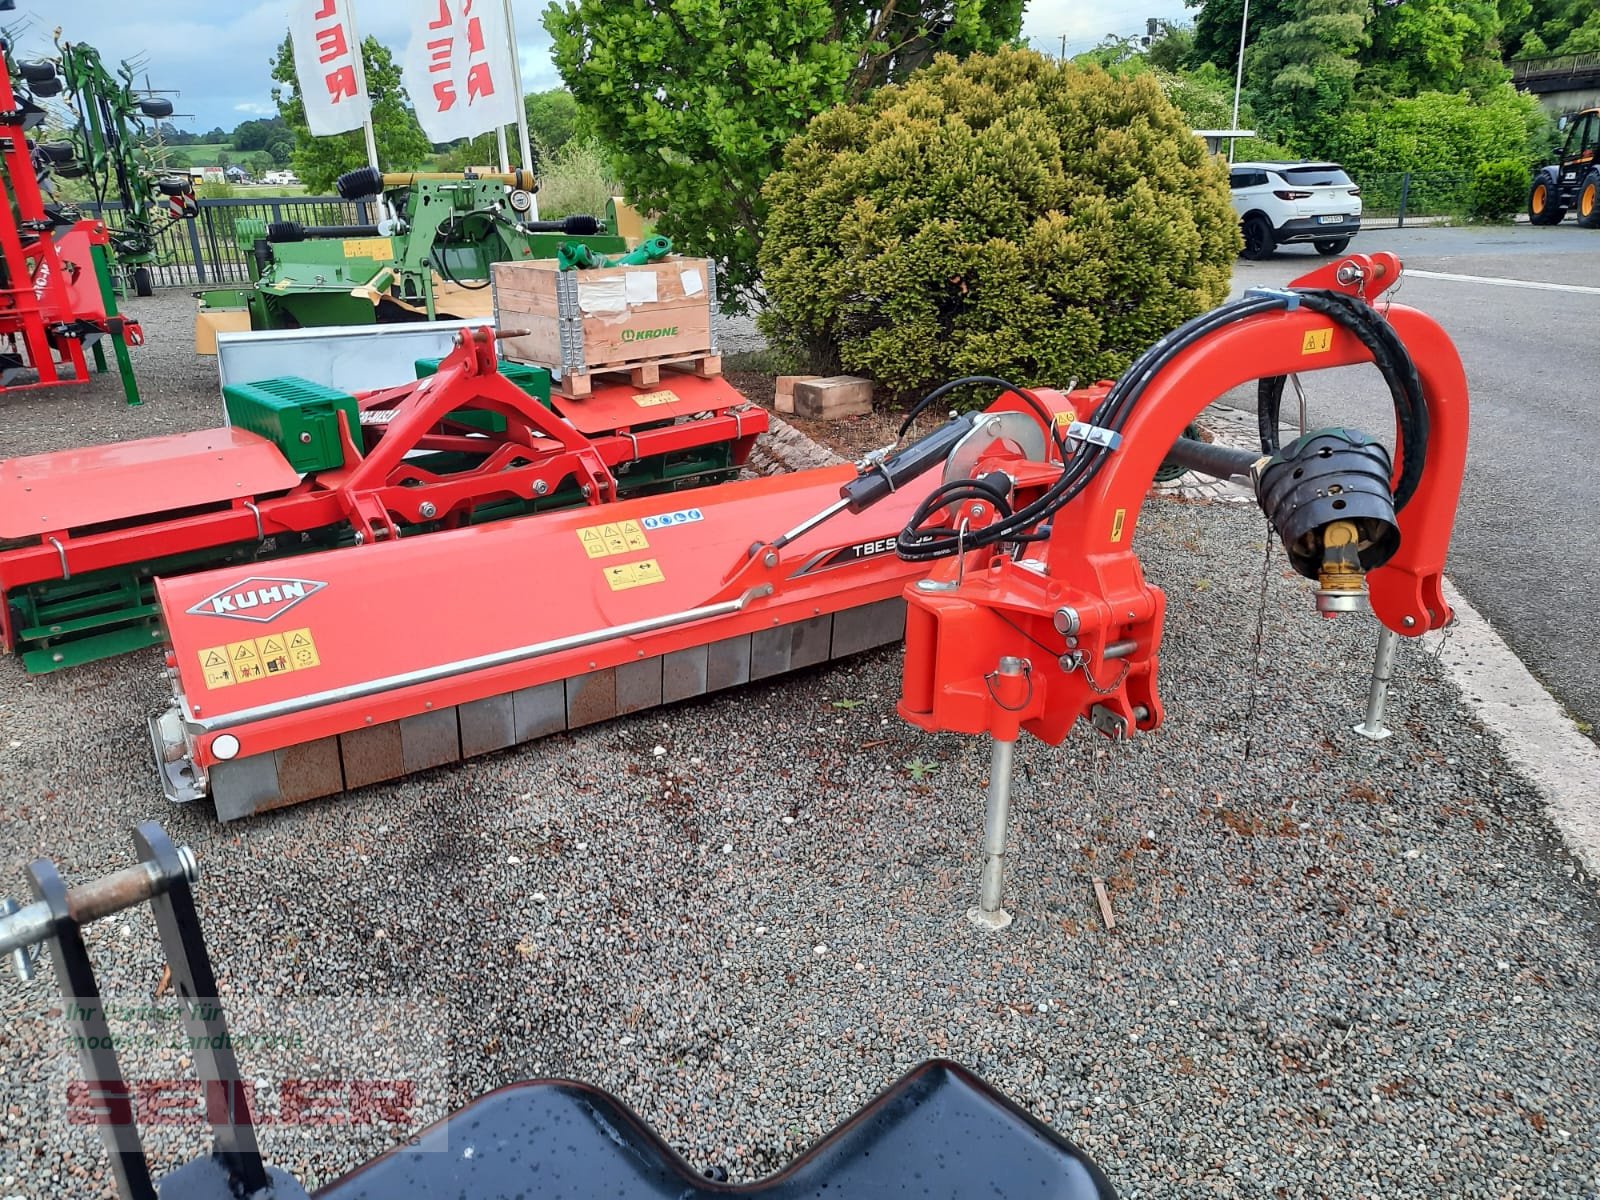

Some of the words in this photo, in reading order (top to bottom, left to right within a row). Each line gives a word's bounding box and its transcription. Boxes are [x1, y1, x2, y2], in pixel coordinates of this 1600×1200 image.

[636, 326, 678, 341] KRONE
[853, 537, 896, 557] TBES
[212, 581, 306, 613] KUHN
